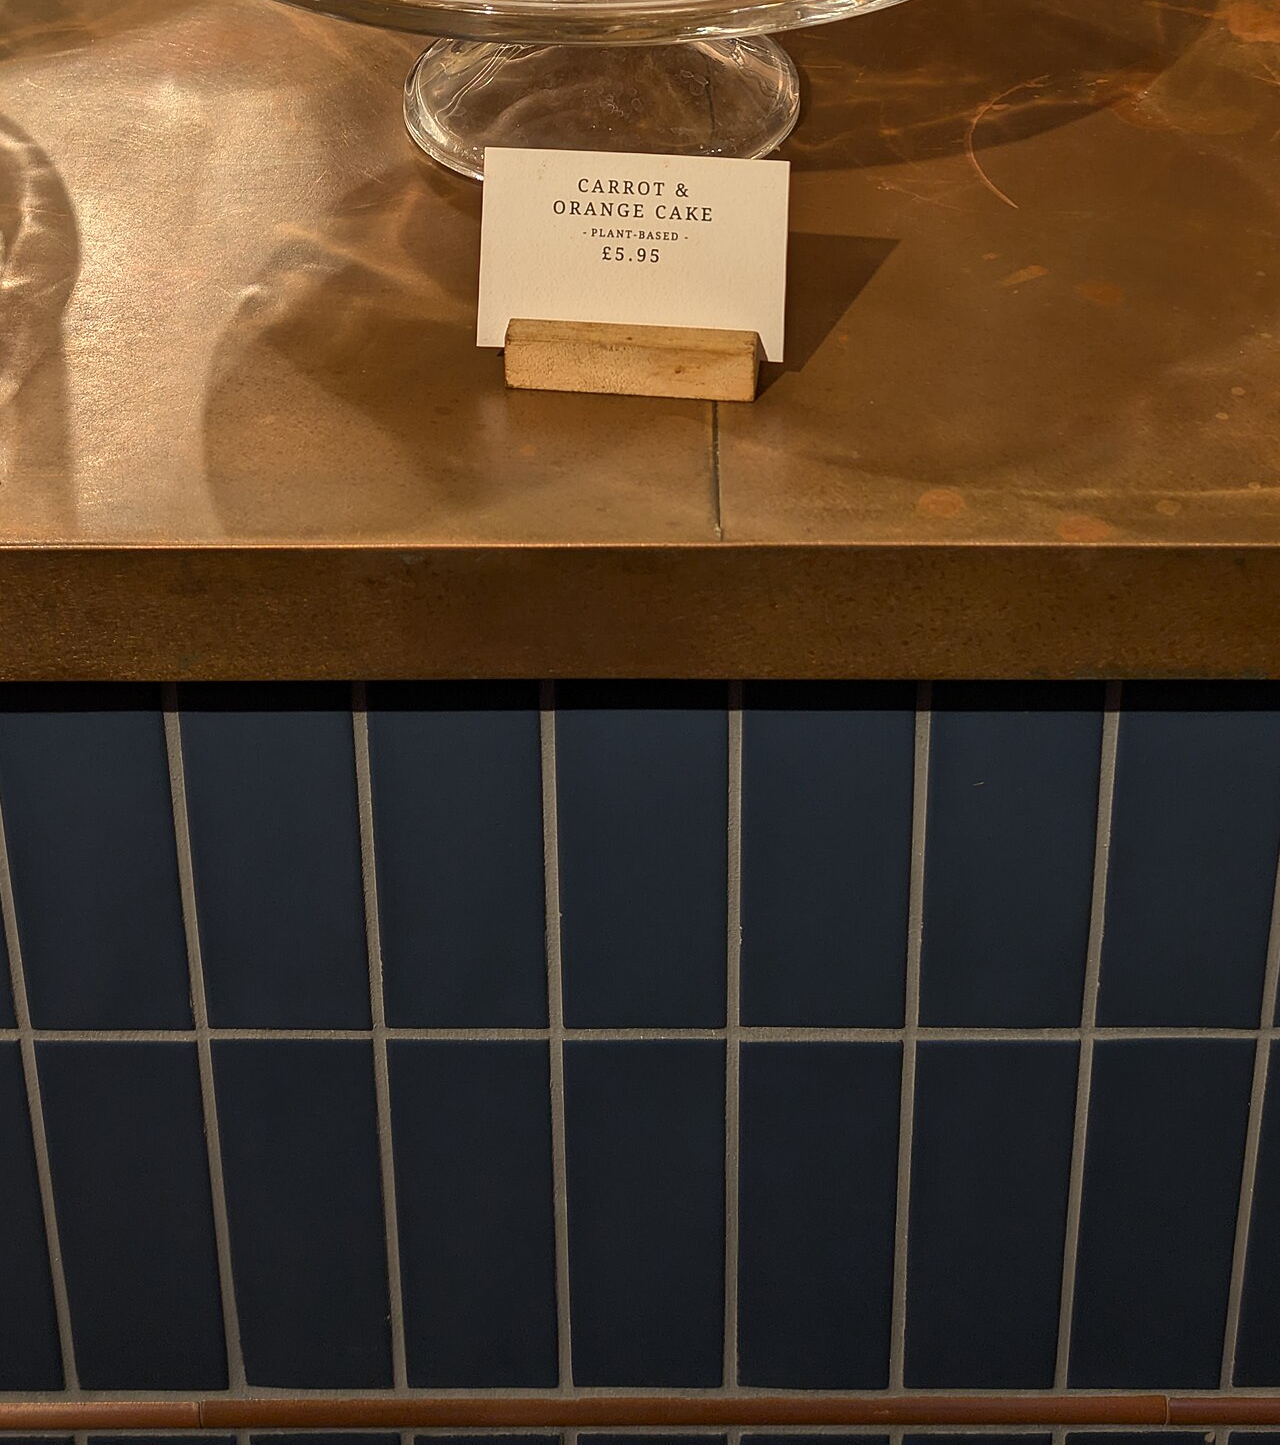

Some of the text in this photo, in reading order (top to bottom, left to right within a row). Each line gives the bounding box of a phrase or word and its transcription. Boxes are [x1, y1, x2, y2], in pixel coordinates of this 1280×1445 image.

[577, 178, 690, 198] CARROT &
[553, 200, 713, 222] ORANGE CAKE
[591, 227, 679, 242] PLANT-BASED
[601, 245, 660, 264] £5.95
